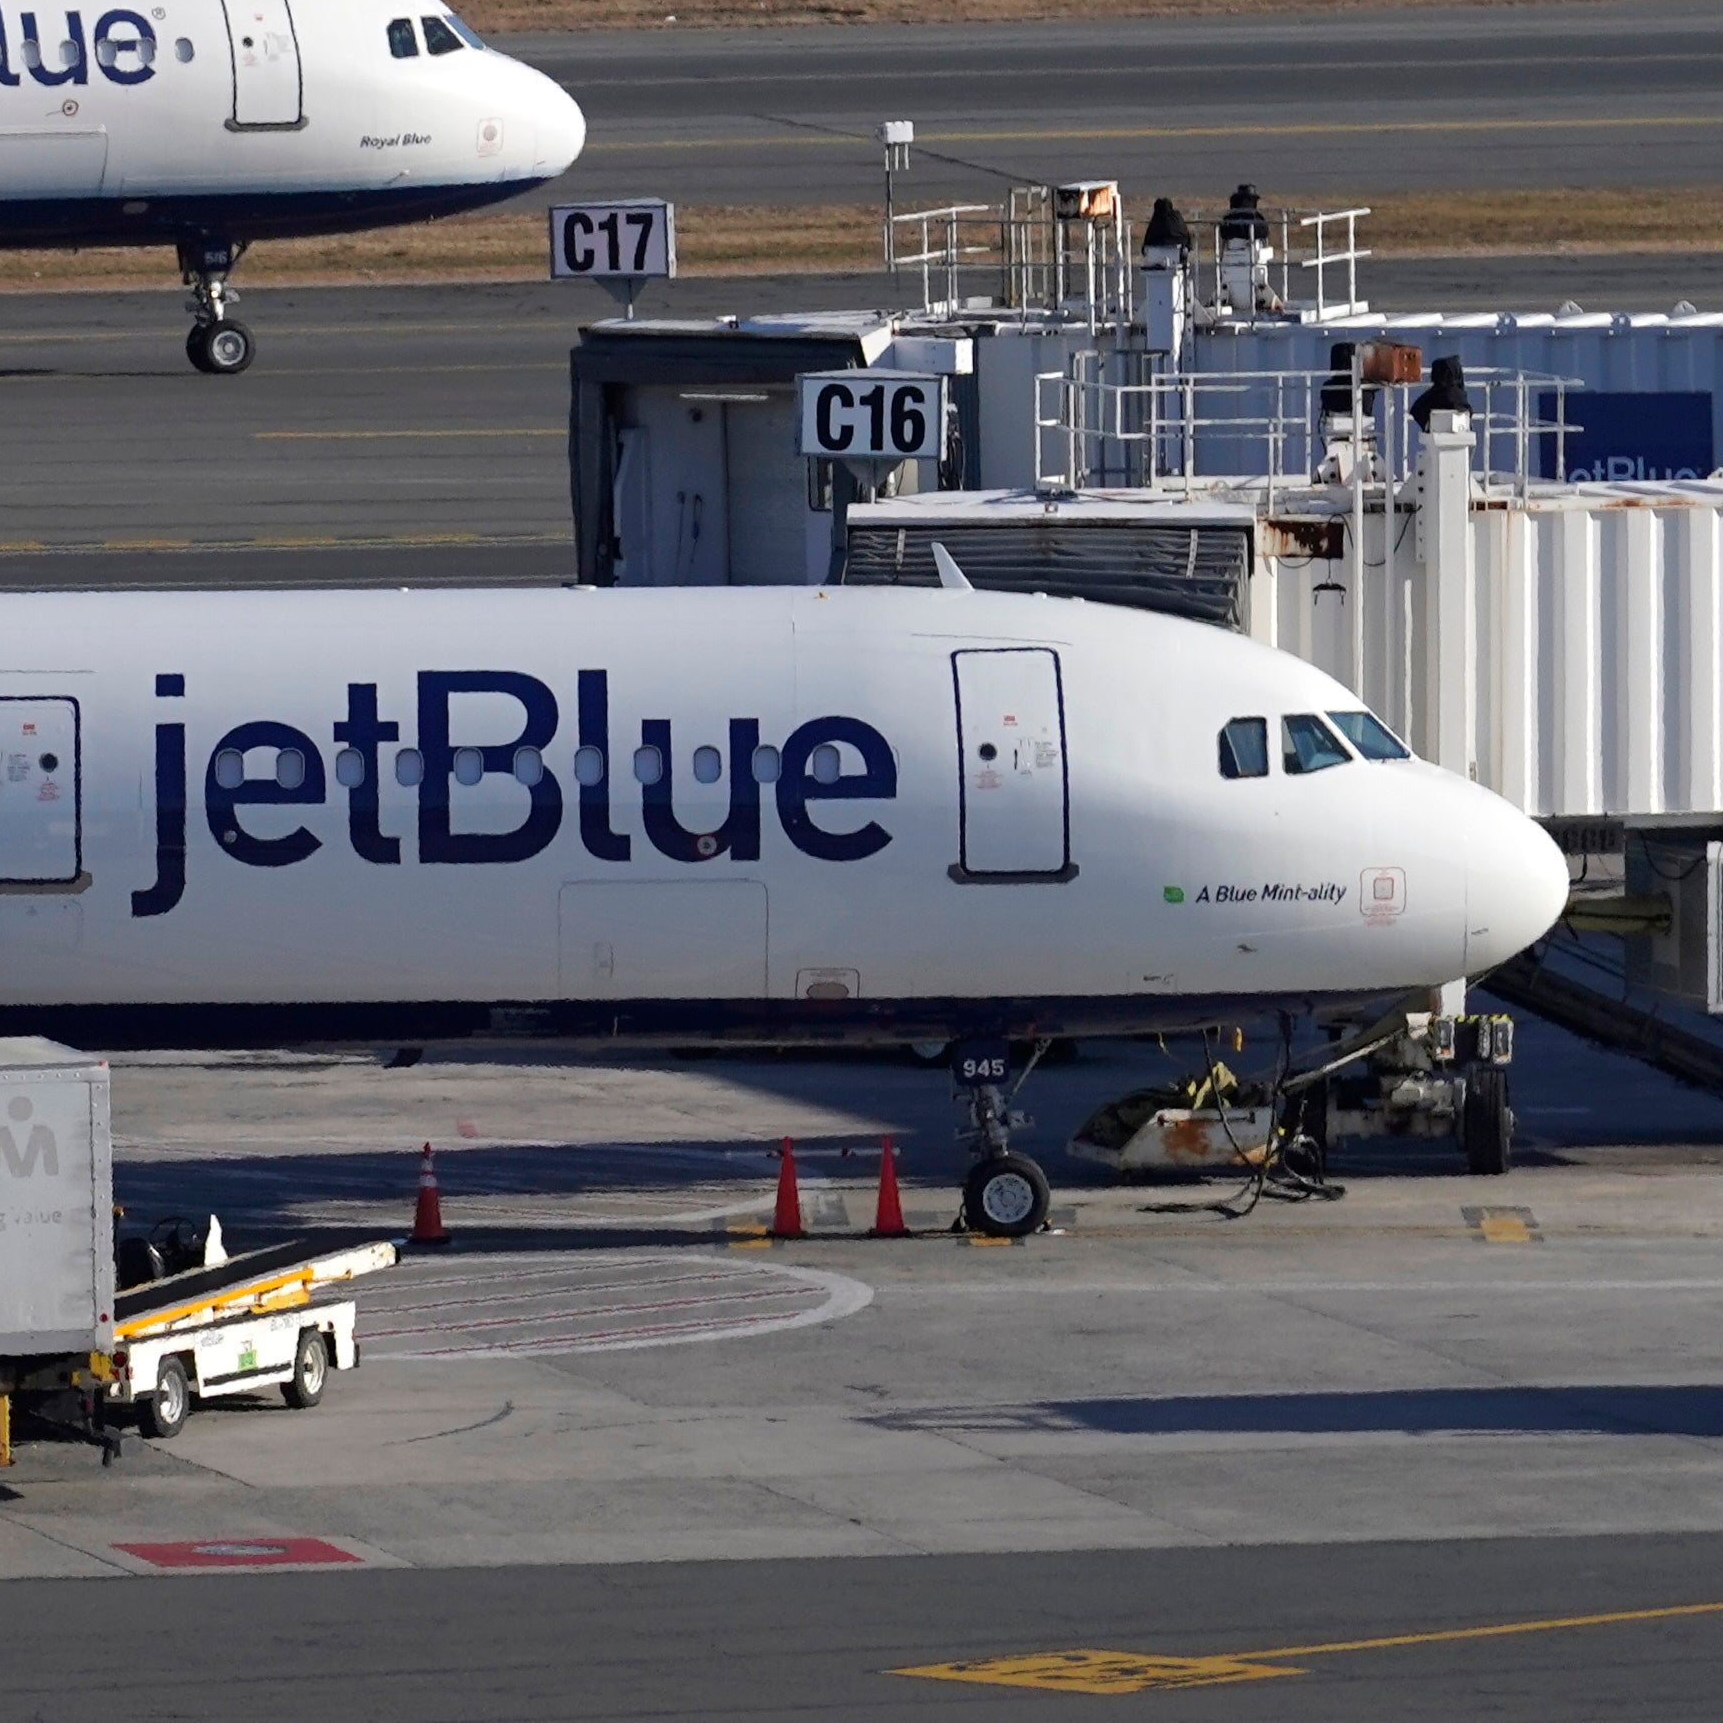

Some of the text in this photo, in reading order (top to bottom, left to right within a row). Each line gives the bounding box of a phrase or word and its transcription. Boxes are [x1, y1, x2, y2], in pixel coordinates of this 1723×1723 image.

[360, 132, 432, 150] Royal Blue
[563, 212, 654, 272] C17
[816, 383, 926, 453] C16
[131, 669, 898, 917] jetBlue
[1196, 883, 1347, 906] A Blue Mint-ality
[963, 1059, 1005, 1077] 945
[13, 1207, 63, 1227] alue
